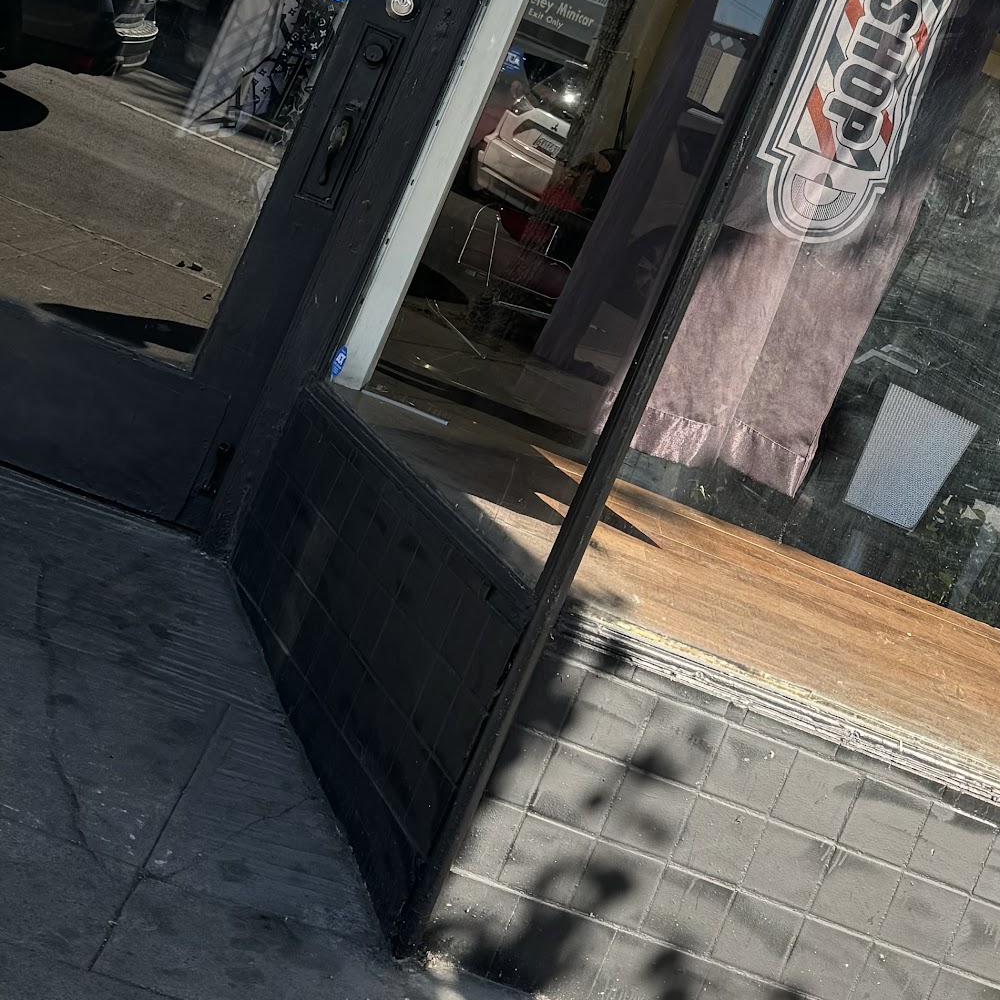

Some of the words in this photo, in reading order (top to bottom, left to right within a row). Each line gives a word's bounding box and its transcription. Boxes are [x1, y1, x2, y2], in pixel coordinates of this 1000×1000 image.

[528, 8, 544, 20] Exit
[546, 15, 564, 30] Only
[556, 2, 594, 27] Minicar
